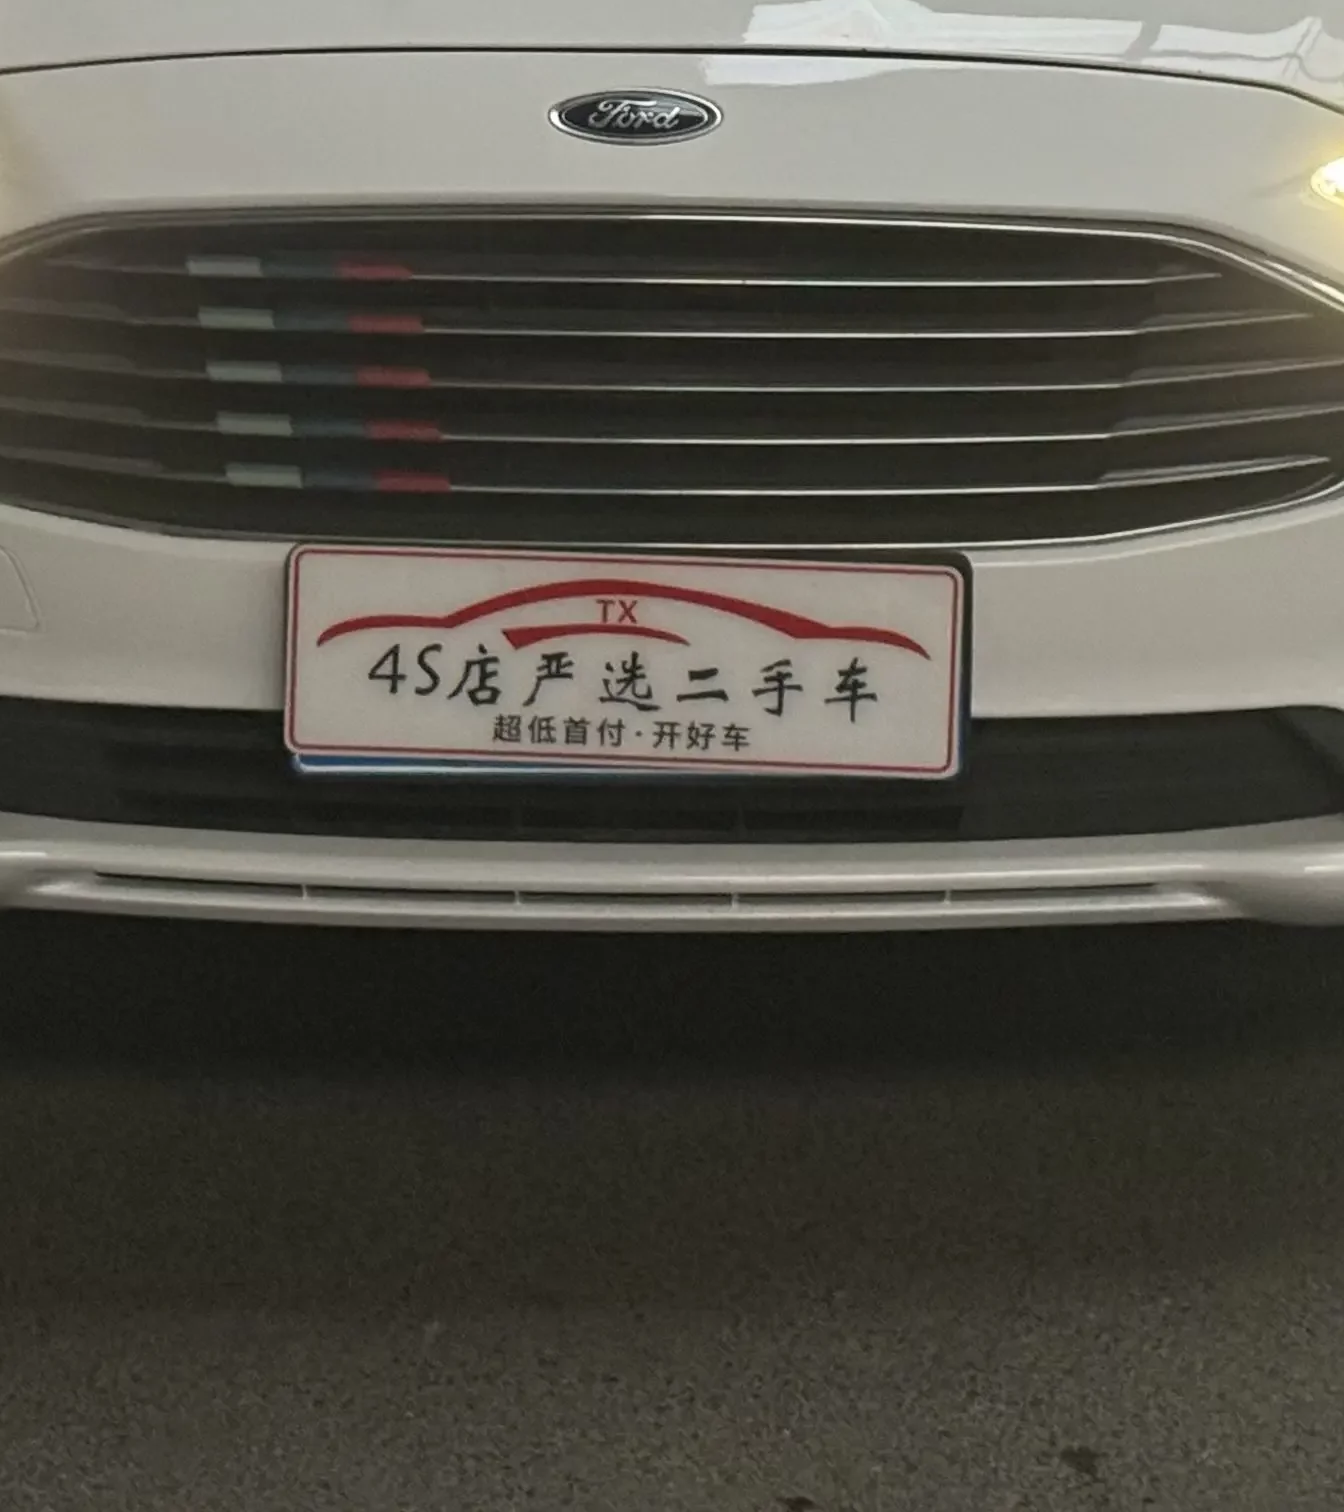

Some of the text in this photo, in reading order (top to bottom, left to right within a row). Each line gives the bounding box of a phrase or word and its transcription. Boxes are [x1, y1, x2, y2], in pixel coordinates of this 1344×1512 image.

[588, 99, 681, 129] Ford
[596, 599, 639, 625] TX
[367, 643, 879, 723] 4S店严选二手车
